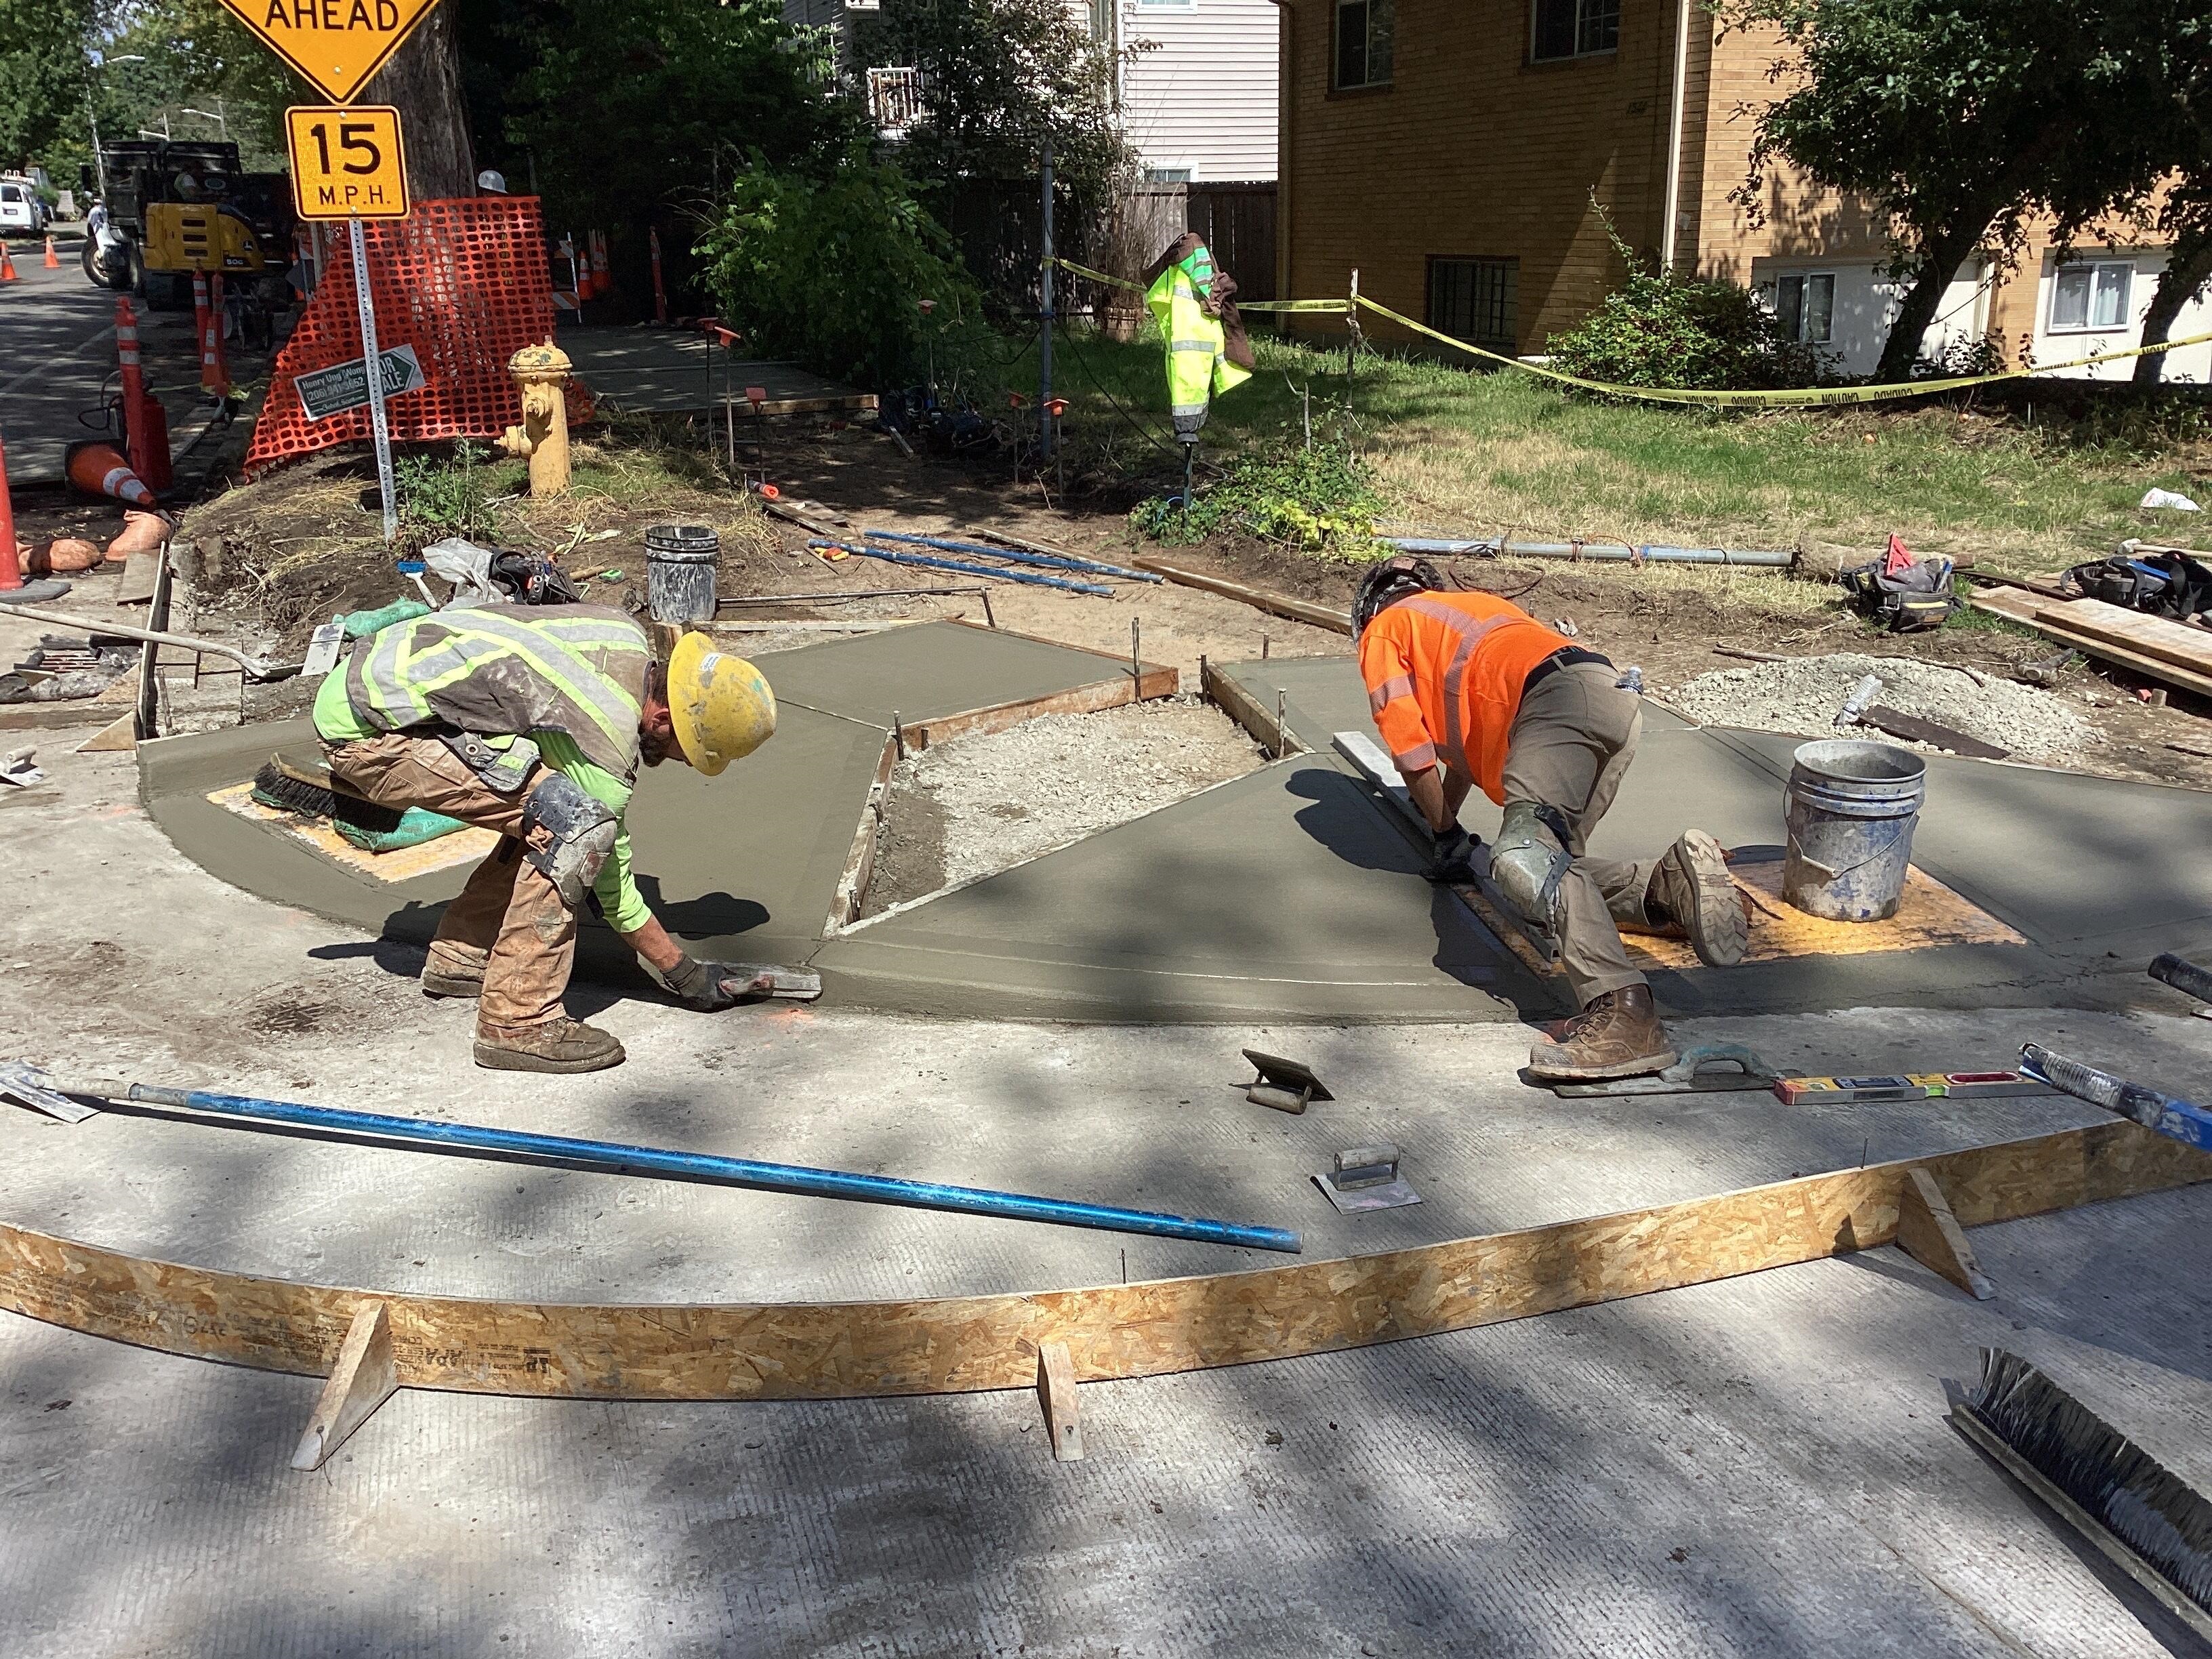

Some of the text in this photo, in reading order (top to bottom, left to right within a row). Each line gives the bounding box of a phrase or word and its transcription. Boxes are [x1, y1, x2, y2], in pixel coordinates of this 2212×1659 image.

[265, 0, 398, 31] AHEAD
[310, 123, 381, 175] 15
[319, 185, 391, 205] M.P.H.
[380, 356, 396, 373] OR
[302, 377, 325, 389] Henry
[383, 371, 405, 392] ALE
[1731, 396, 1766, 406] CUIDADO
[1821, 392, 1860, 405] CAUTION
